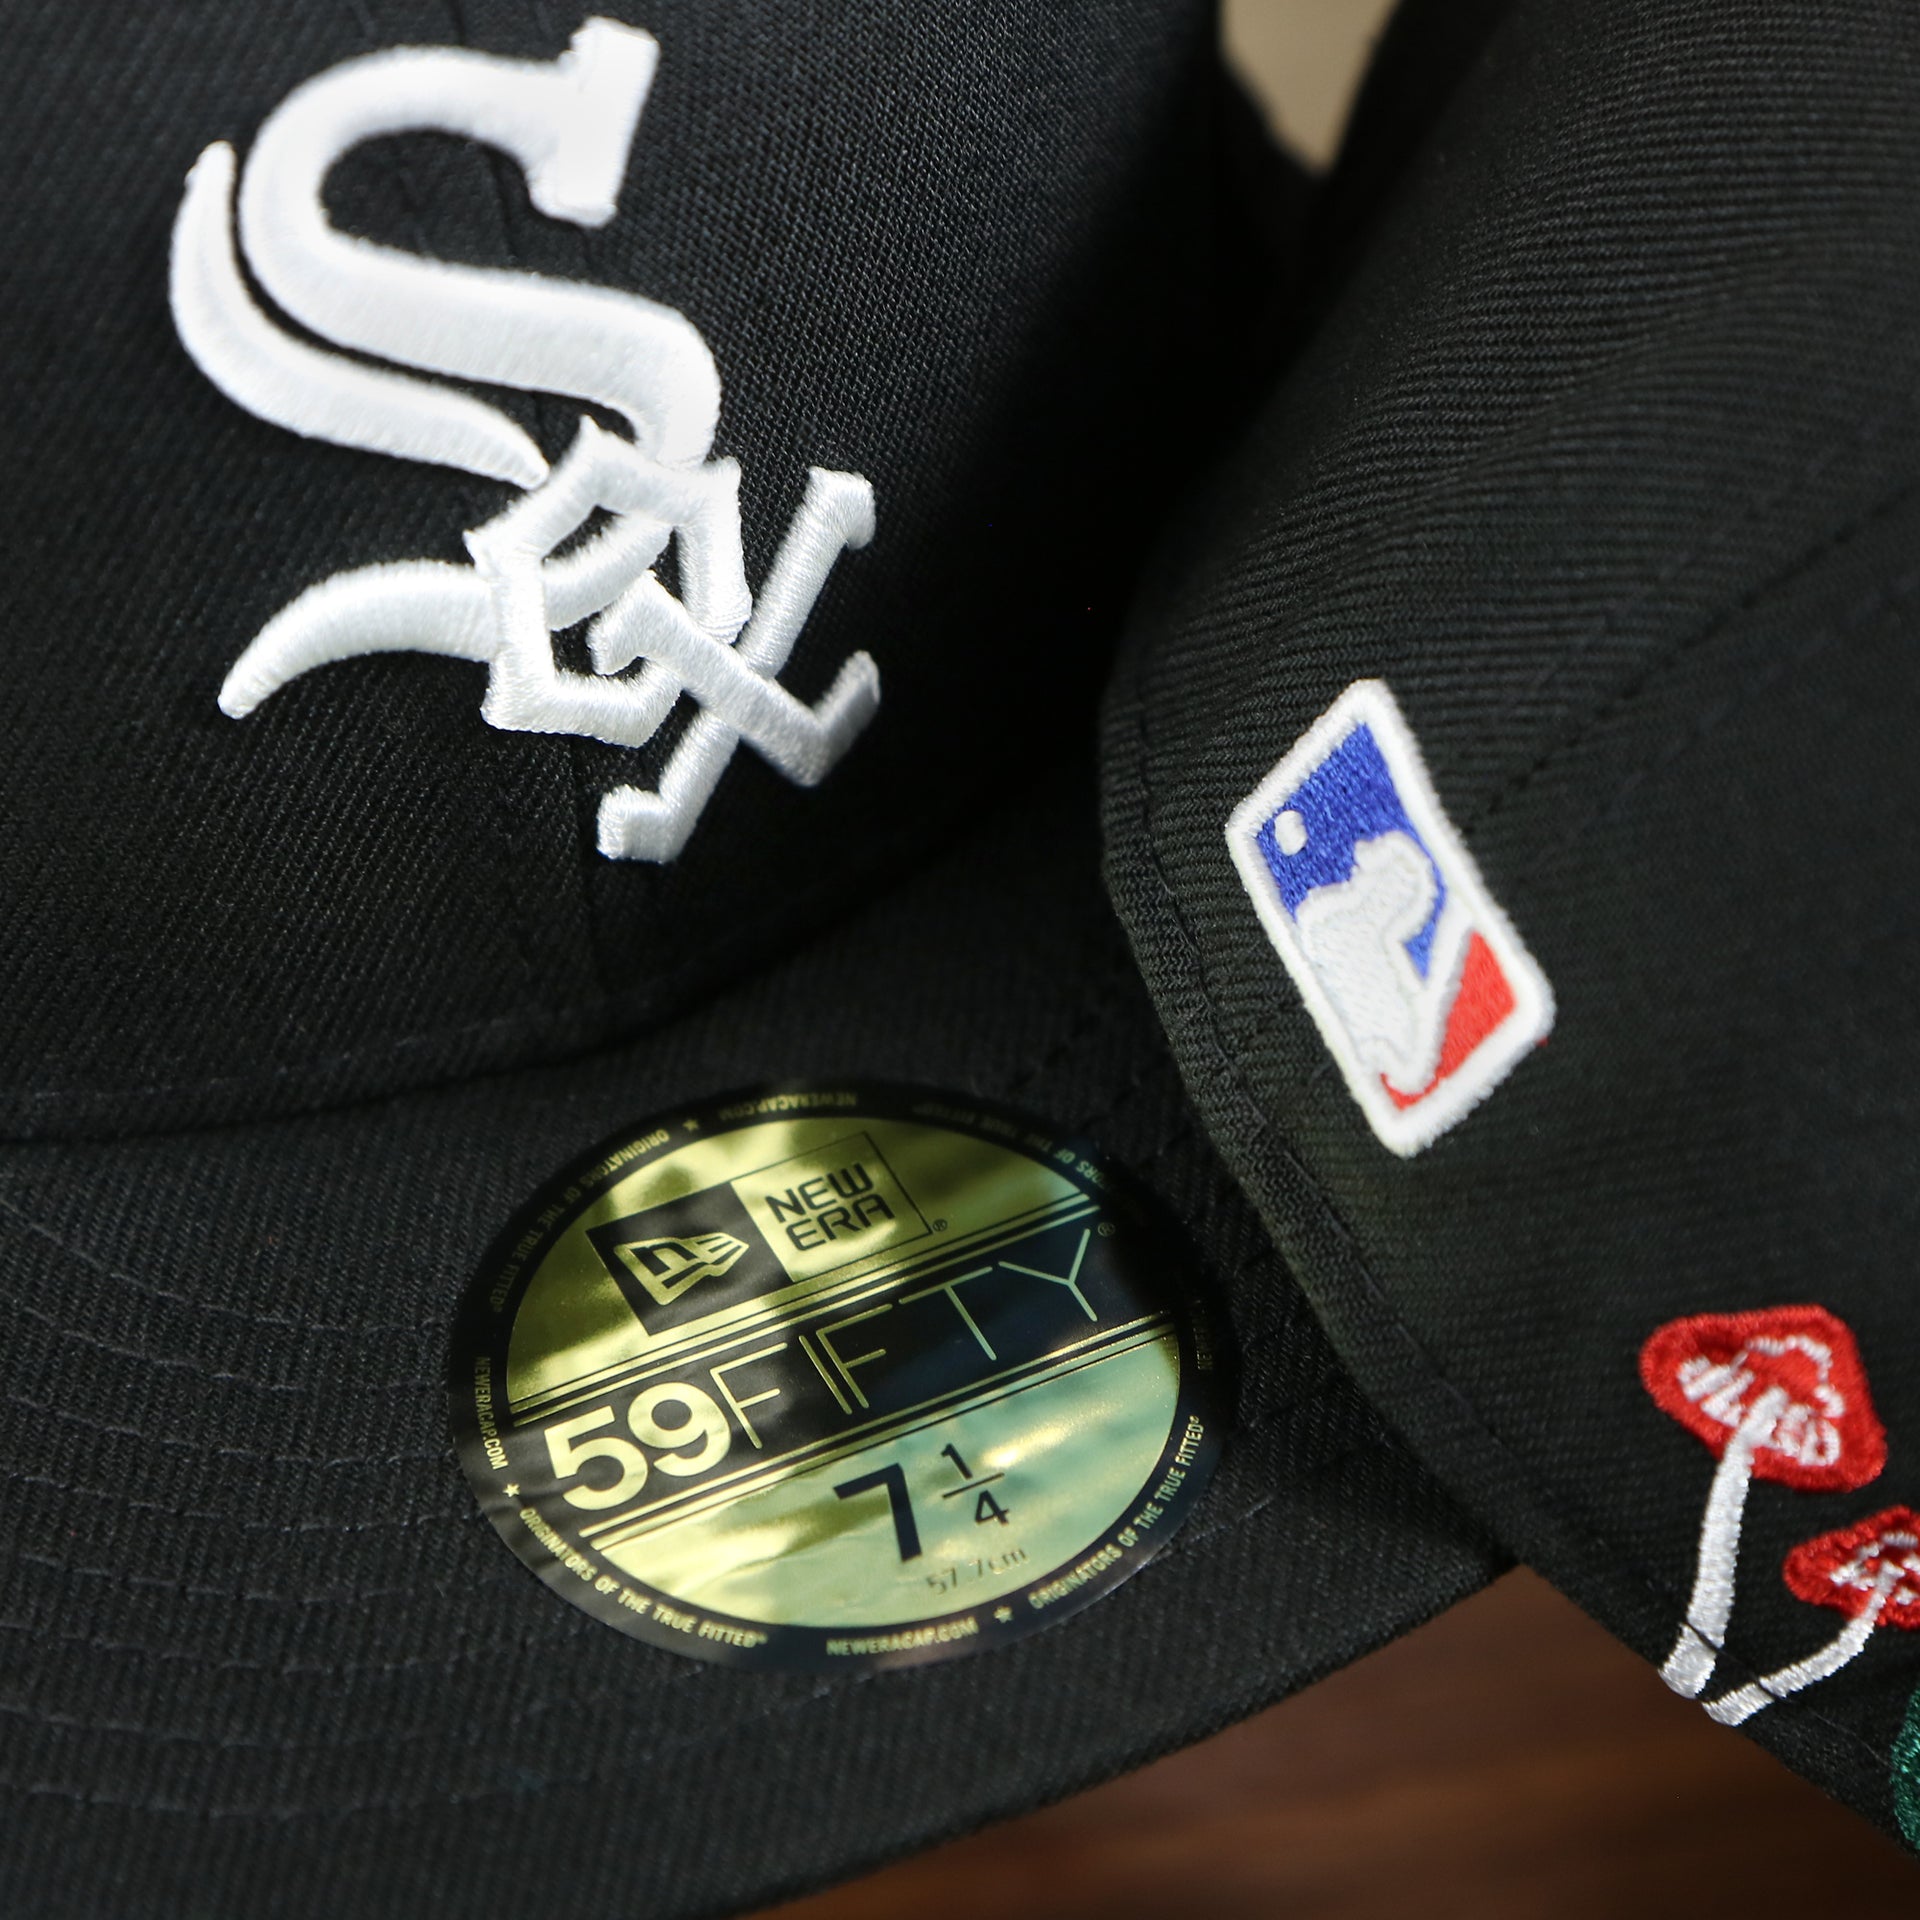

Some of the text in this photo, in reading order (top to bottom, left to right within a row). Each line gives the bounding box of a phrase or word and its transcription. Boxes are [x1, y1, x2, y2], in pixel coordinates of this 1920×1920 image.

[764, 1162, 875, 1223] NEW
[785, 1192, 896, 1252] ERA
[474, 1355, 509, 1470] NEWERACAP.COM
[544, 1229, 1098, 1510] 59FIFTY
[833, 1463, 923, 1563] 7
[1028, 1544, 1123, 1609] ORIGINATORS
[1117, 1526, 1139, 1547] OF
[1133, 1501, 1164, 1529] THE
[1154, 1466, 1186, 1502] TRUE
[520, 1507, 598, 1581] ORIGINATORS
[594, 1575, 621, 1595] OF
[618, 1587, 652, 1615] THE
[652, 1603, 698, 1634] TRUE
[826, 1615, 980, 1656] NEWERACAP.COM
